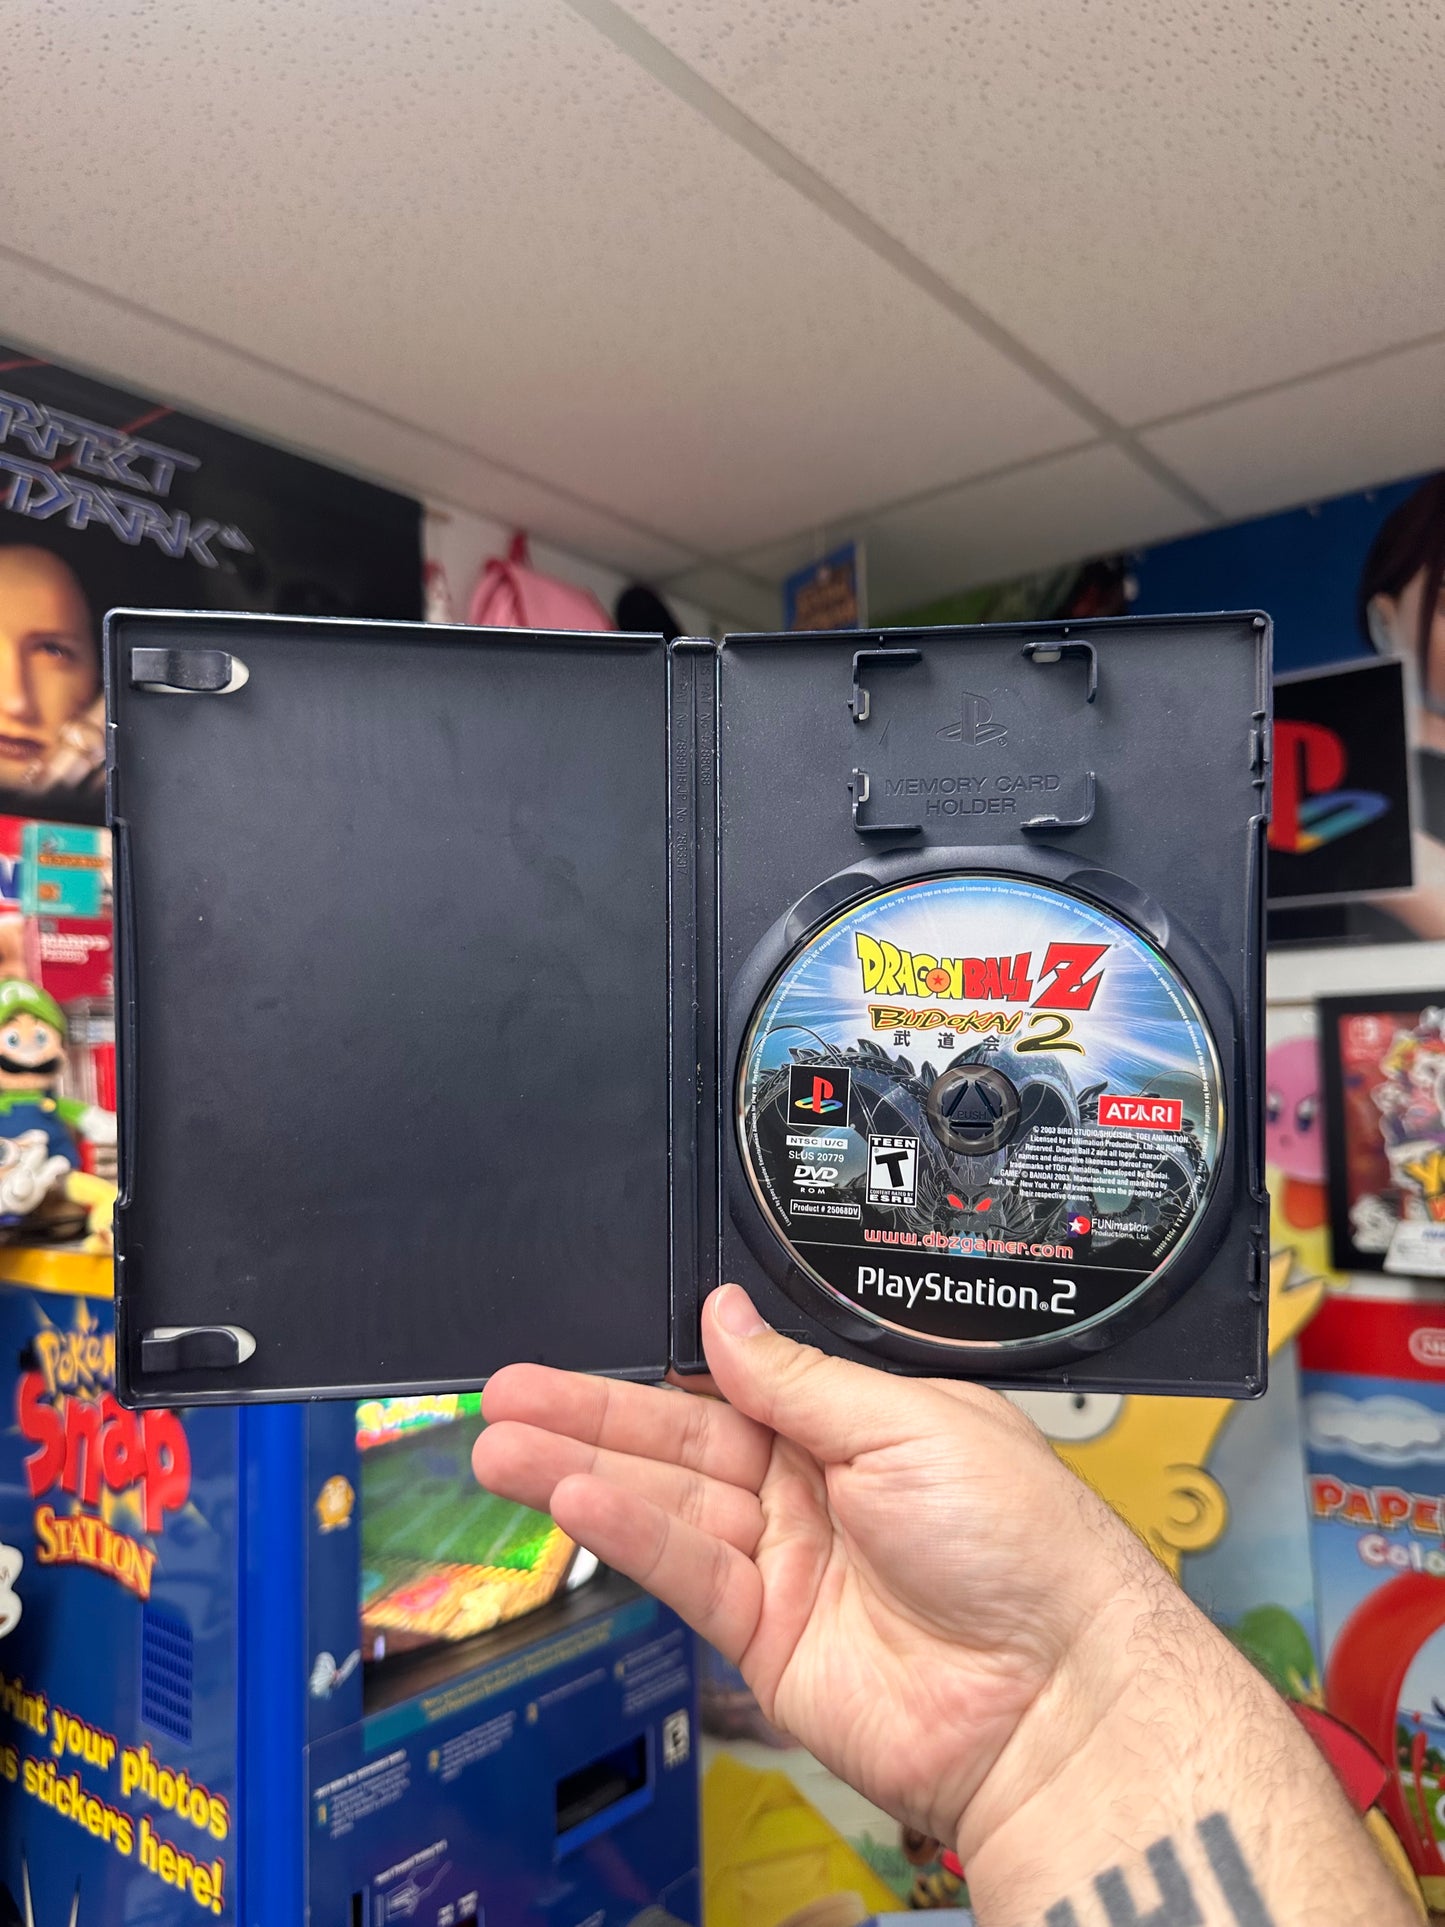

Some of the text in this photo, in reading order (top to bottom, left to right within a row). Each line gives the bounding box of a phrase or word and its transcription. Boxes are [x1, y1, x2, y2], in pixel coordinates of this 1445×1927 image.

[885, 774, 1061, 796] MEMORY CARD
[926, 797, 1017, 817] HOLDER
[1031, 942, 1112, 1010] Z
[868, 1004, 1086, 1056] BUDOKAI 2
[958, 1110, 987, 1119] PUSH
[1106, 1102, 1173, 1123] ATARI
[1040, 1126, 1056, 1134] 2003
[1057, 1127, 1073, 1135] BIRD
[790, 1137, 818, 1145] NTSC
[871, 1137, 916, 1148] TEEN
[1030, 1134, 1057, 1143] Licensed
[1067, 1138, 1104, 1148] FUNimation
[1156, 1143, 1165, 1151] All
[1166, 1144, 1185, 1153] Rights
[788, 1150, 845, 1163] SLUS 20779
[1025, 1143, 1054, 1152] Reserved.
[1055, 1146, 1077, 1155] Dragon
[1078, 1147, 1090, 1155] Ball
[1096, 1149, 1107, 1157] and
[1139, 1152, 1168, 1161] character
[1053, 1154, 1084, 1163] distinctive
[1085, 1157, 1117, 1166] likenesses
[1119, 1159, 1141, 1168] thereof
[794, 1165, 839, 1180] DVD
[874, 1150, 909, 1188] T
[1009, 1161, 1044, 1170] trademarks
[1045, 1163, 1052, 1171] of
[1068, 1165, 1101, 1174] Animation.
[1103, 1168, 1136, 1178] Developed
[1137, 1170, 1145, 1179] by
[1146, 1170, 1170, 1180] Bandai.
[1000, 1169, 1020, 1178] GAME:
[1029, 1171, 1053, 1179] BANDAI
[1054, 1173, 1072, 1181] 2003.
[1073, 1174, 1116, 1184] Manufactured
[1117, 1178, 1129, 1186] and
[1130, 1179, 1159, 1188] marketed
[1160, 1181, 1168, 1190] by
[870, 1194, 914, 1204] ESRB
[1020, 1189, 1092, 1202] their respective owners.
[1034, 1181, 1049, 1190] York,
[1050, 1182, 1061, 1190] NY.
[1072, 1184, 1105, 1193] trademarks
[1117, 1187, 1127, 1195] the
[1128, 1188, 1154, 1199] property
[1155, 1190, 1162, 1198] of
[793, 1203, 819, 1212] Product
[827, 1206, 859, 1216] 25068DV
[1091, 1218, 1148, 1232] FUNimation
[1091, 1229, 1151, 1240] Productions, Ltd.
[864, 1229, 1074, 1260] www.dbzgamer.com
[1050, 1278, 1077, 1315] 2
[17, 1366, 190, 1534] Snap
[1307, 1474, 1445, 1534] PAPE
[35, 1505, 155, 1602] STATION
[0, 1676, 231, 1840] rint your photos
[22, 1755, 134, 1857] stickers
[139, 1814, 225, 1915] here!
